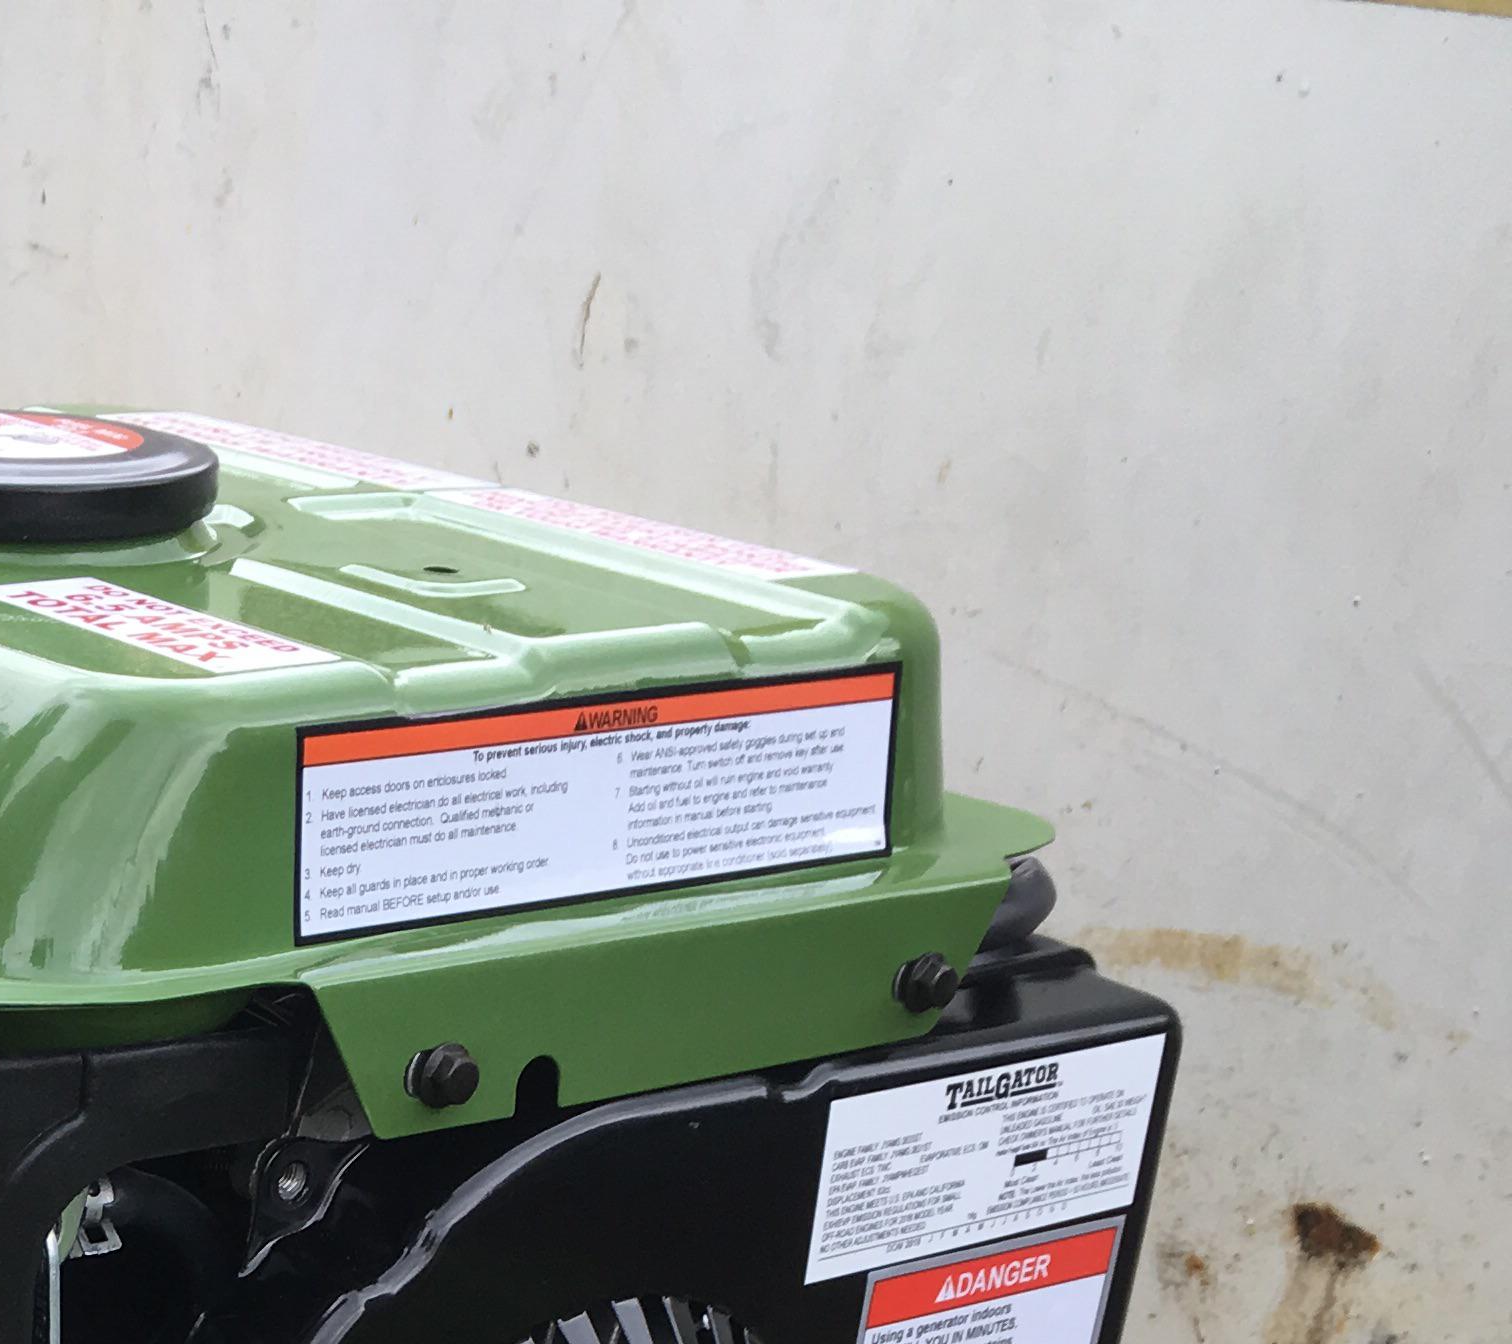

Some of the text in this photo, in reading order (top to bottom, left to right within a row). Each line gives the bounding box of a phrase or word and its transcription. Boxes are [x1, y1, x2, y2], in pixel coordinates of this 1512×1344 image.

[88, 585, 128, 597] DO
[129, 598, 191, 614] NOT
[8, 590, 232, 663] TOTAL MAX
[129, 615, 249, 650] AMPS
[589, 705, 657, 729] WARNING
[472, 723, 712, 762] To prevent serious injury, electric shock, and property
[382, 893, 423, 910] BEFORE
[945, 1062, 1059, 1110] TAILGATOR
[954, 1253, 1051, 1298] DANGER
[905, 1327, 913, 1338] a
[915, 1314, 969, 1338] generator
[970, 1303, 1012, 1322] indoors
[950, 1330, 963, 1344] IN
